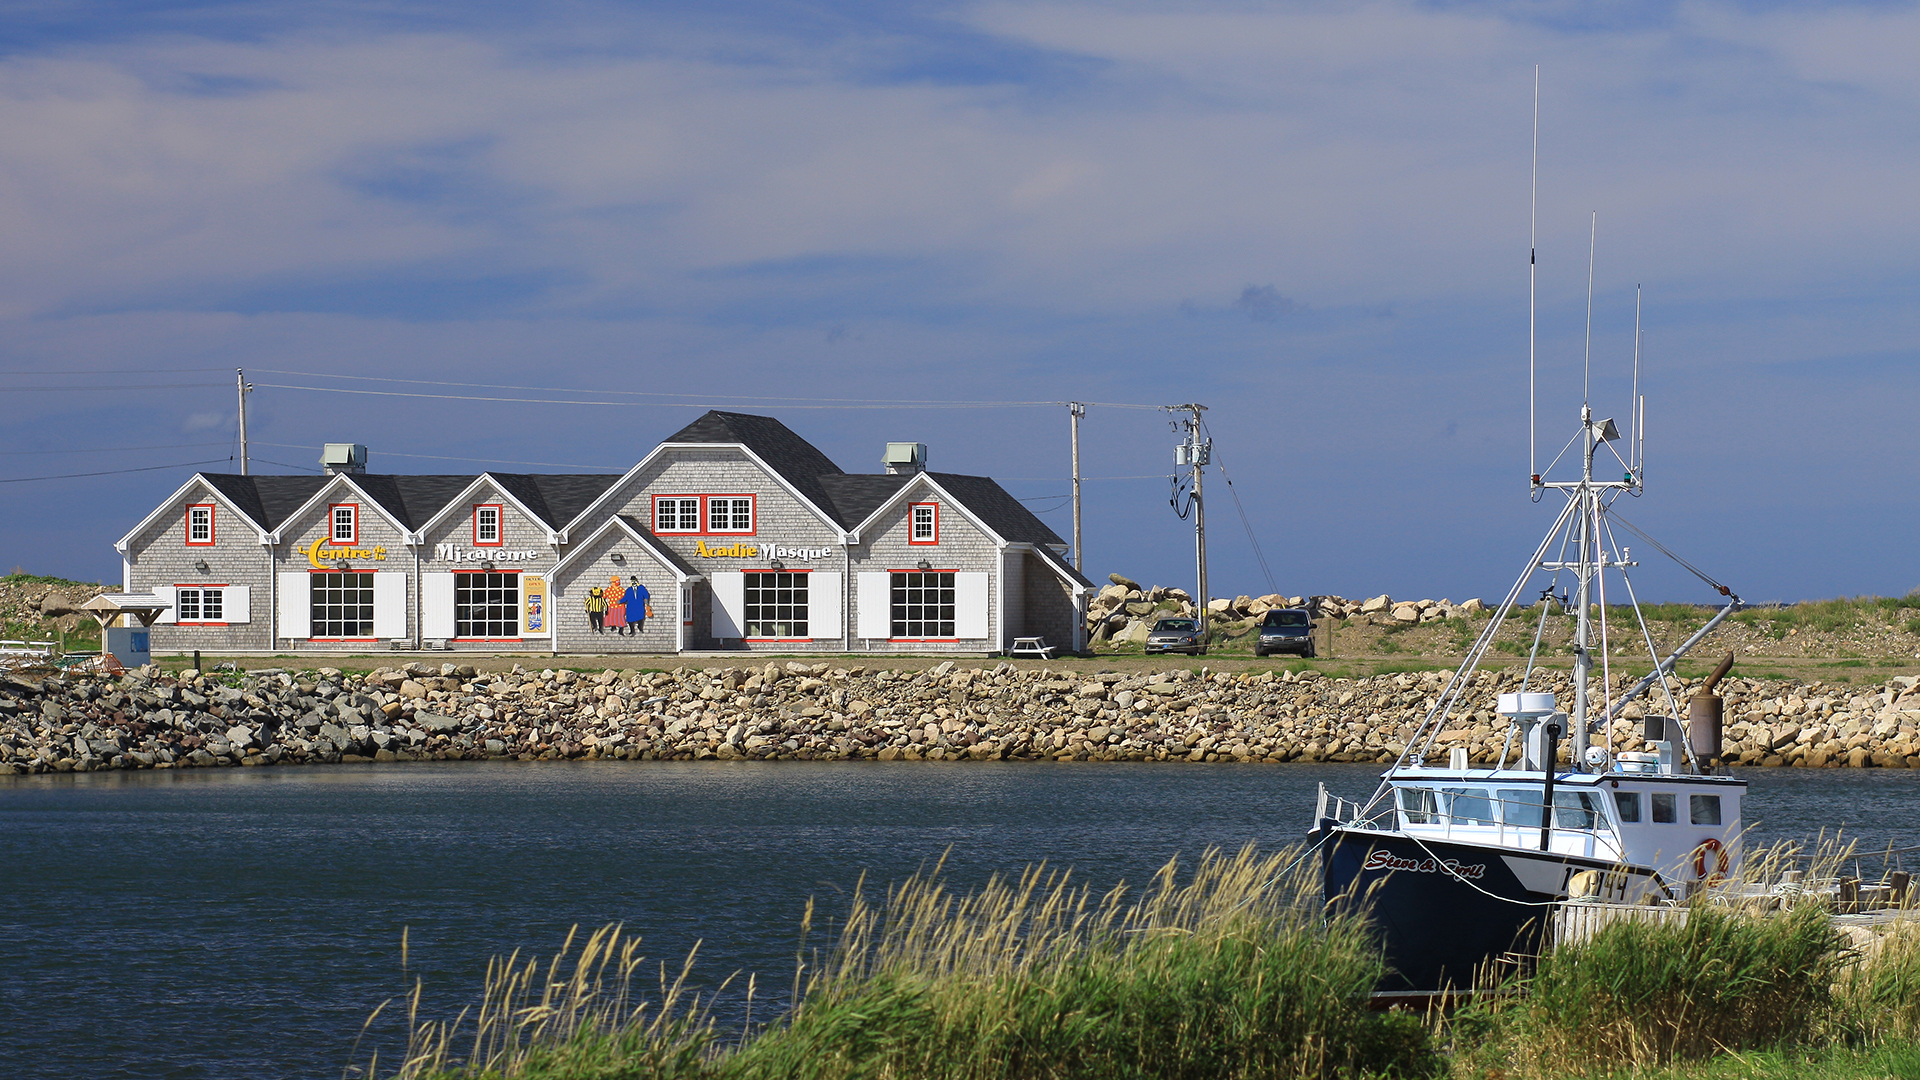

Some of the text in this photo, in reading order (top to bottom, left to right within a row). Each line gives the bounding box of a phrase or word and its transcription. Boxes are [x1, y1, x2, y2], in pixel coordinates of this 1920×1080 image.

[308, 536, 371, 569] Centre
[373, 545, 387, 554] de
[374, 553, 386, 561] la
[435, 543, 538, 564] Mi-carême
[694, 540, 832, 563] Acadie Masque
[1364, 850, 1419, 872] Steve
[1419, 857, 1437, 873] &
